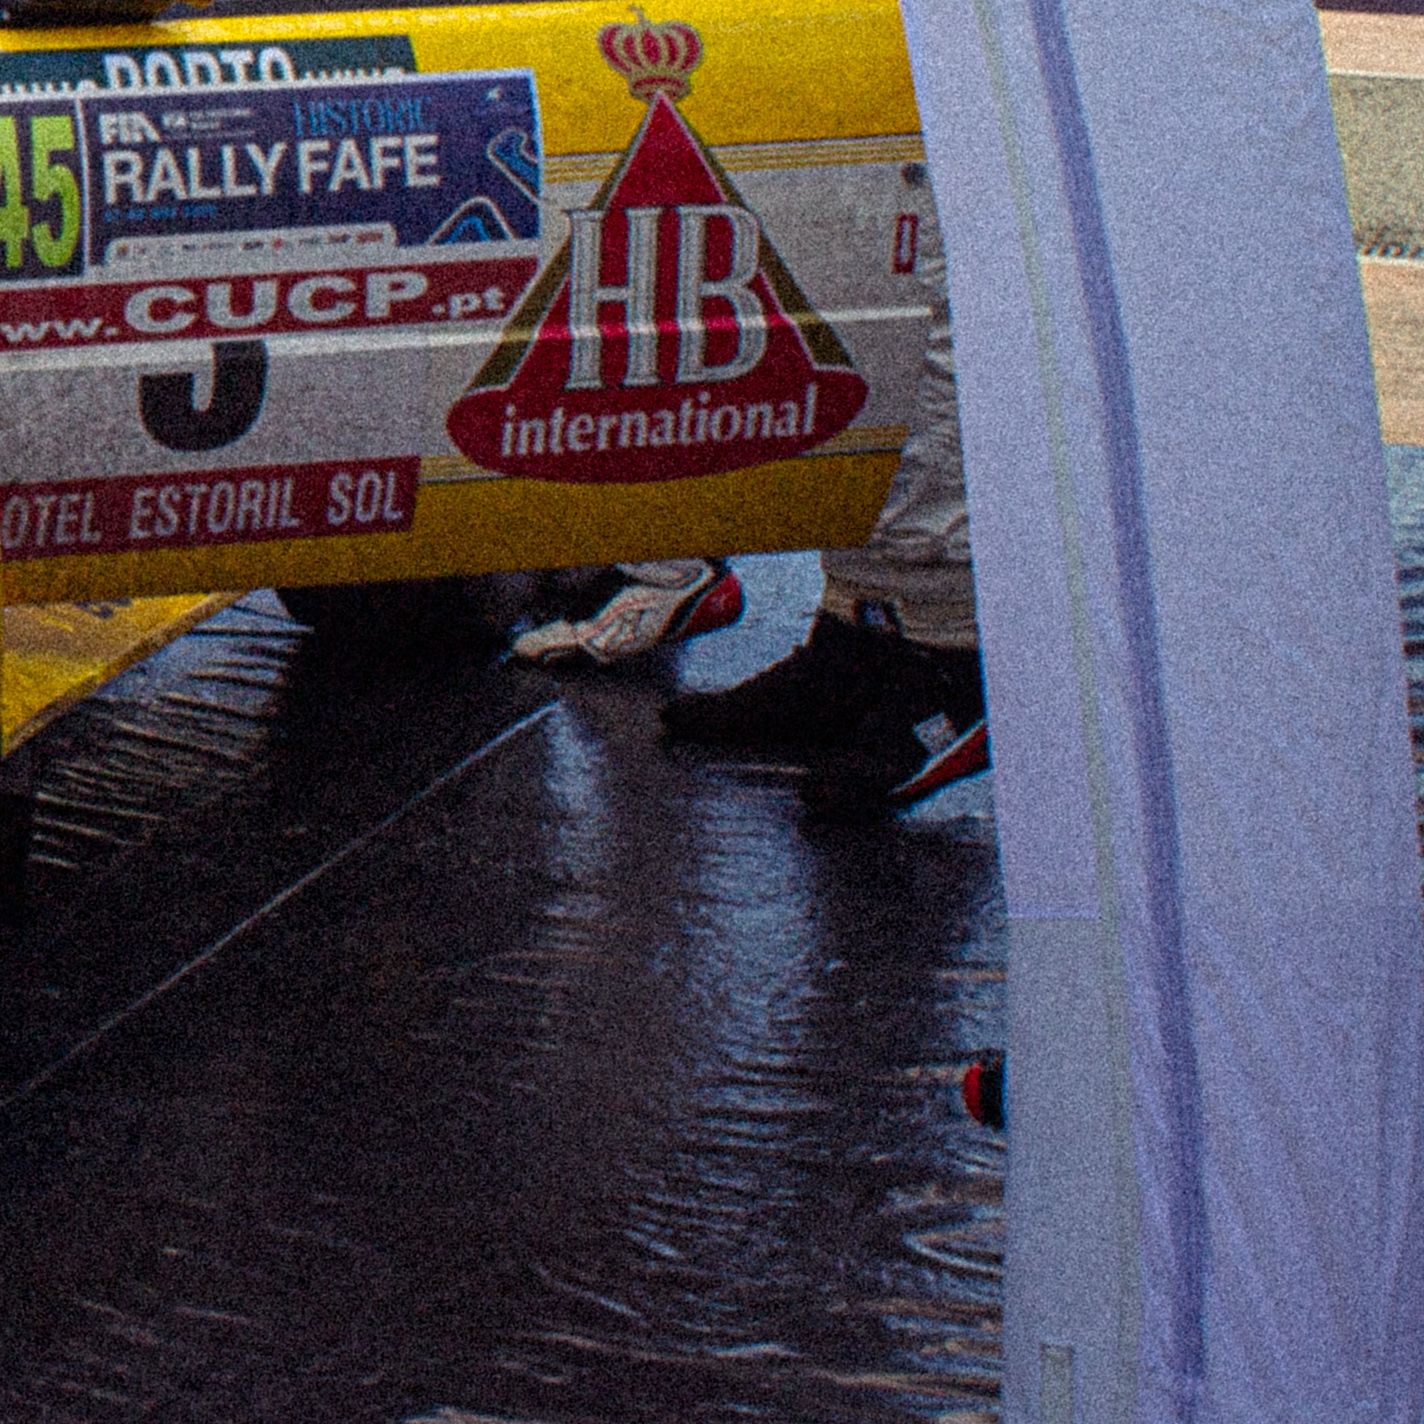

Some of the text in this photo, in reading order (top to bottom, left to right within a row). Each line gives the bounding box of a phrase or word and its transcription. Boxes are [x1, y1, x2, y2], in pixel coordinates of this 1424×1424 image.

[292, 95, 437, 138] HISTORIC
[104, 133, 441, 205] RALLY FAFE
[563, 204, 768, 391] HB
[500, 385, 818, 458] international
[2, 470, 406, 550] OTEL ESTORIL SOL
